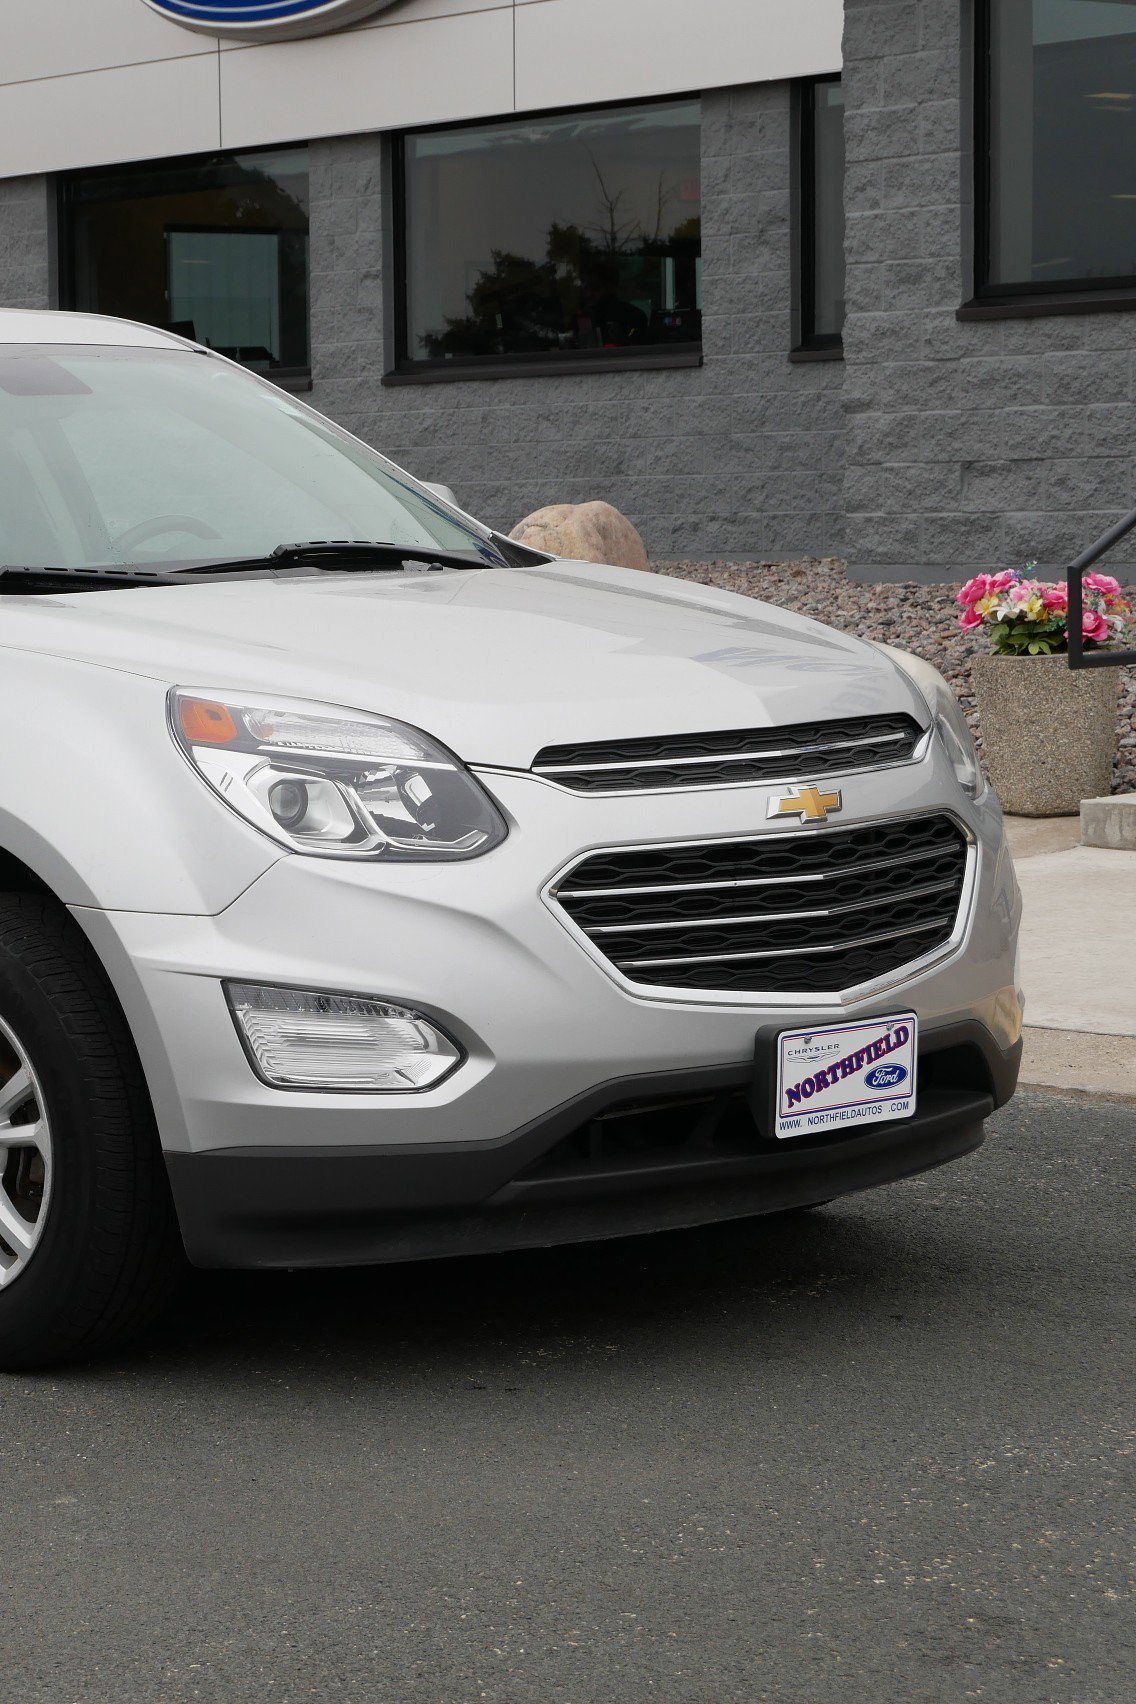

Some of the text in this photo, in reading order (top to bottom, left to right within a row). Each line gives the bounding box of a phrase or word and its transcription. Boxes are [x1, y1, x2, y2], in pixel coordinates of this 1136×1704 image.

[787, 1043, 840, 1056] CHRYSLER
[785, 1025, 910, 1109] NORTHFIELD
[872, 1067, 900, 1085] Ford
